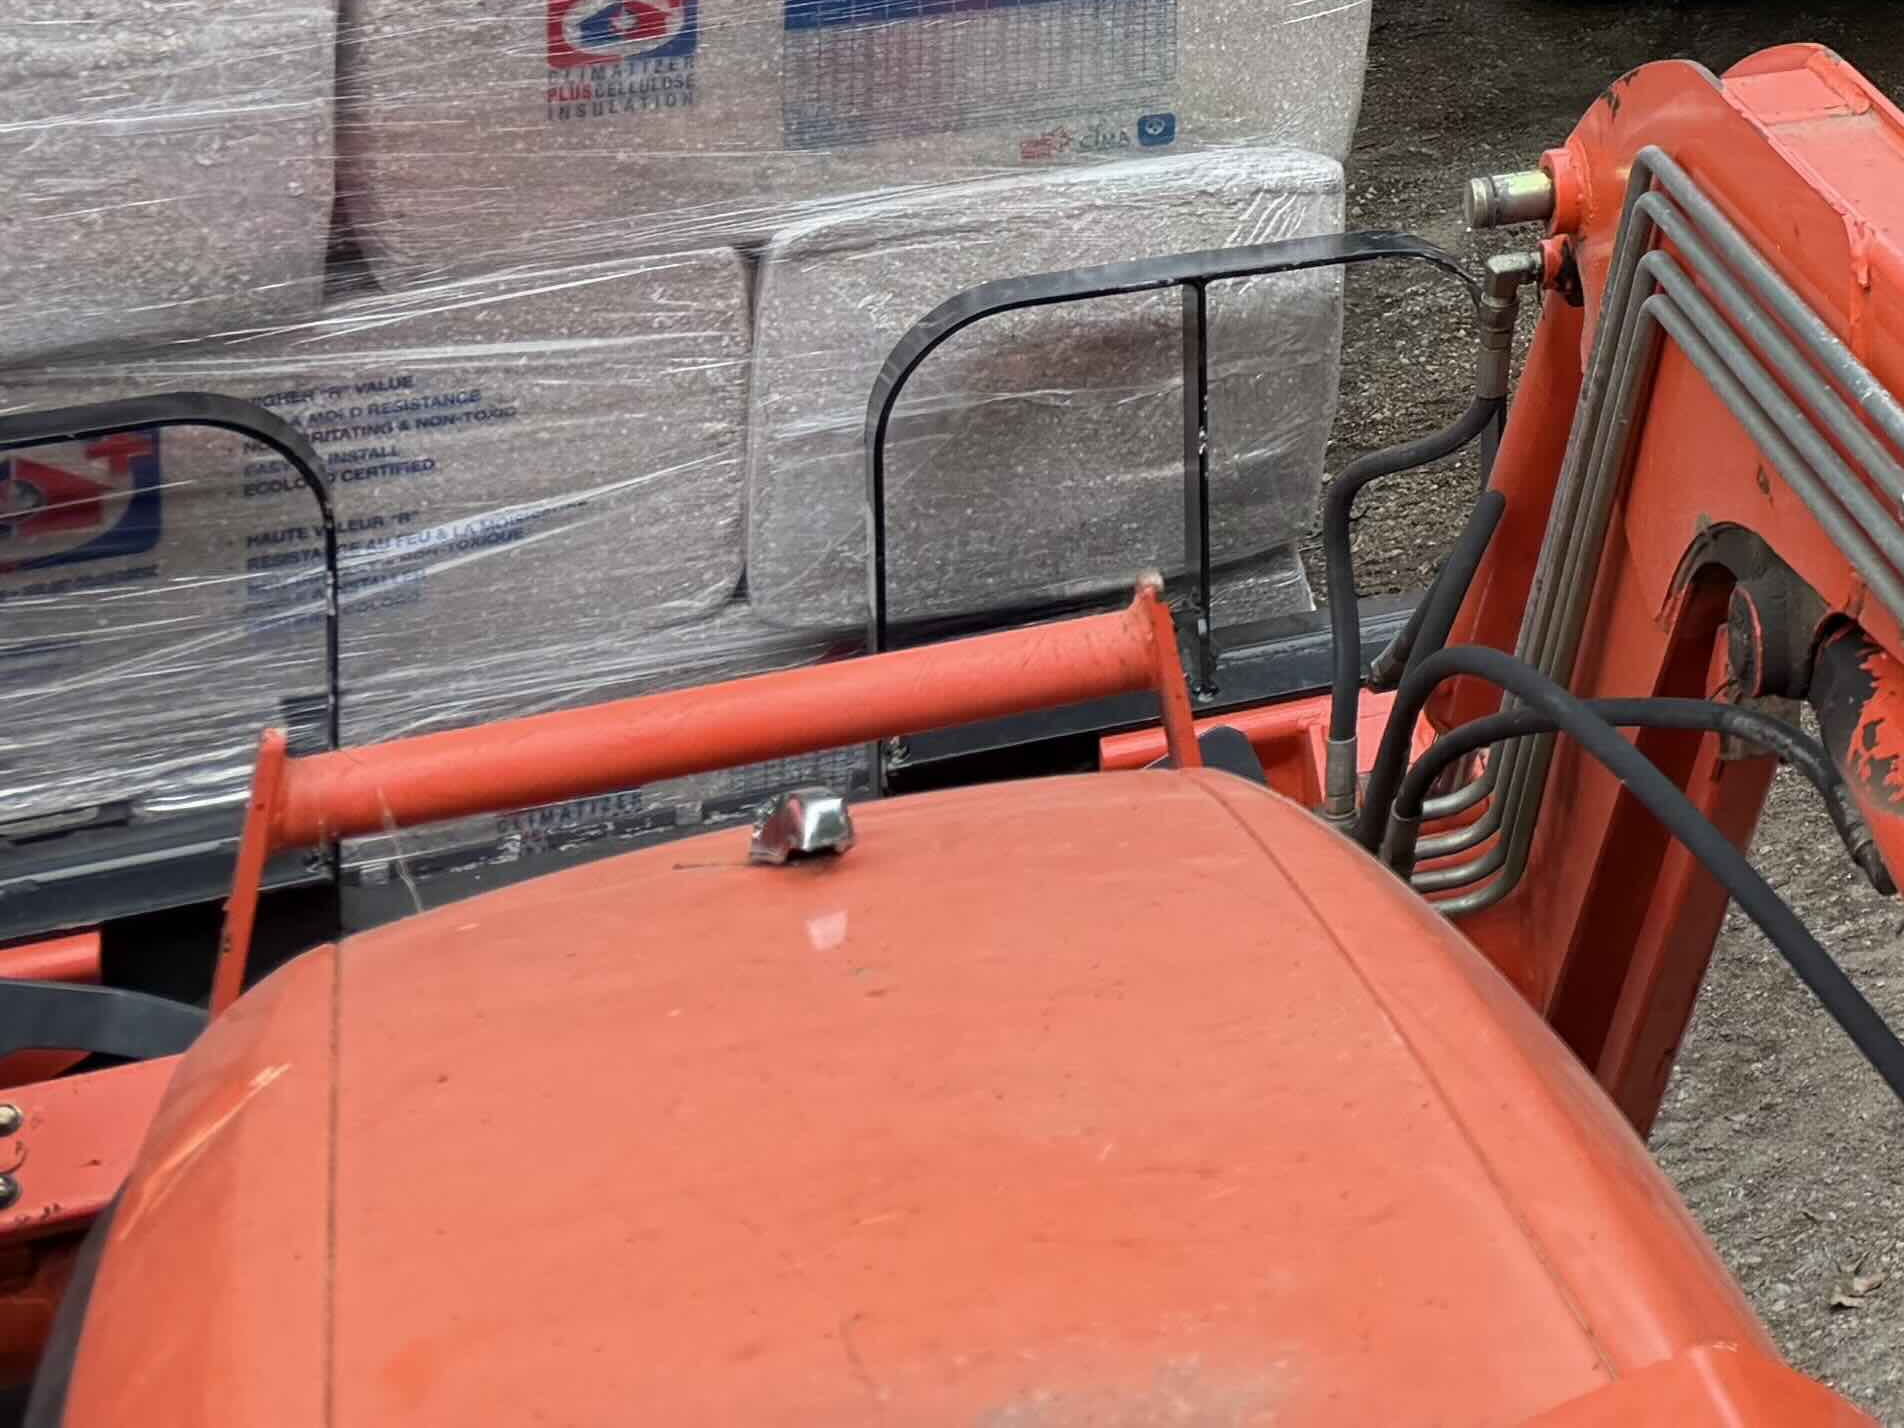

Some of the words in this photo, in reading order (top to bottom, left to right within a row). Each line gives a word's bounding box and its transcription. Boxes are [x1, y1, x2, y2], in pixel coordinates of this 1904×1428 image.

[546, 82, 593, 103] PLUS
[592, 73, 696, 99] CELLULOSE
[546, 92, 694, 121] INSULATION
[353, 375, 414, 396] VALUE
[366, 389, 482, 418] RESISTANCE
[338, 458, 436, 483] CERTIFIED
